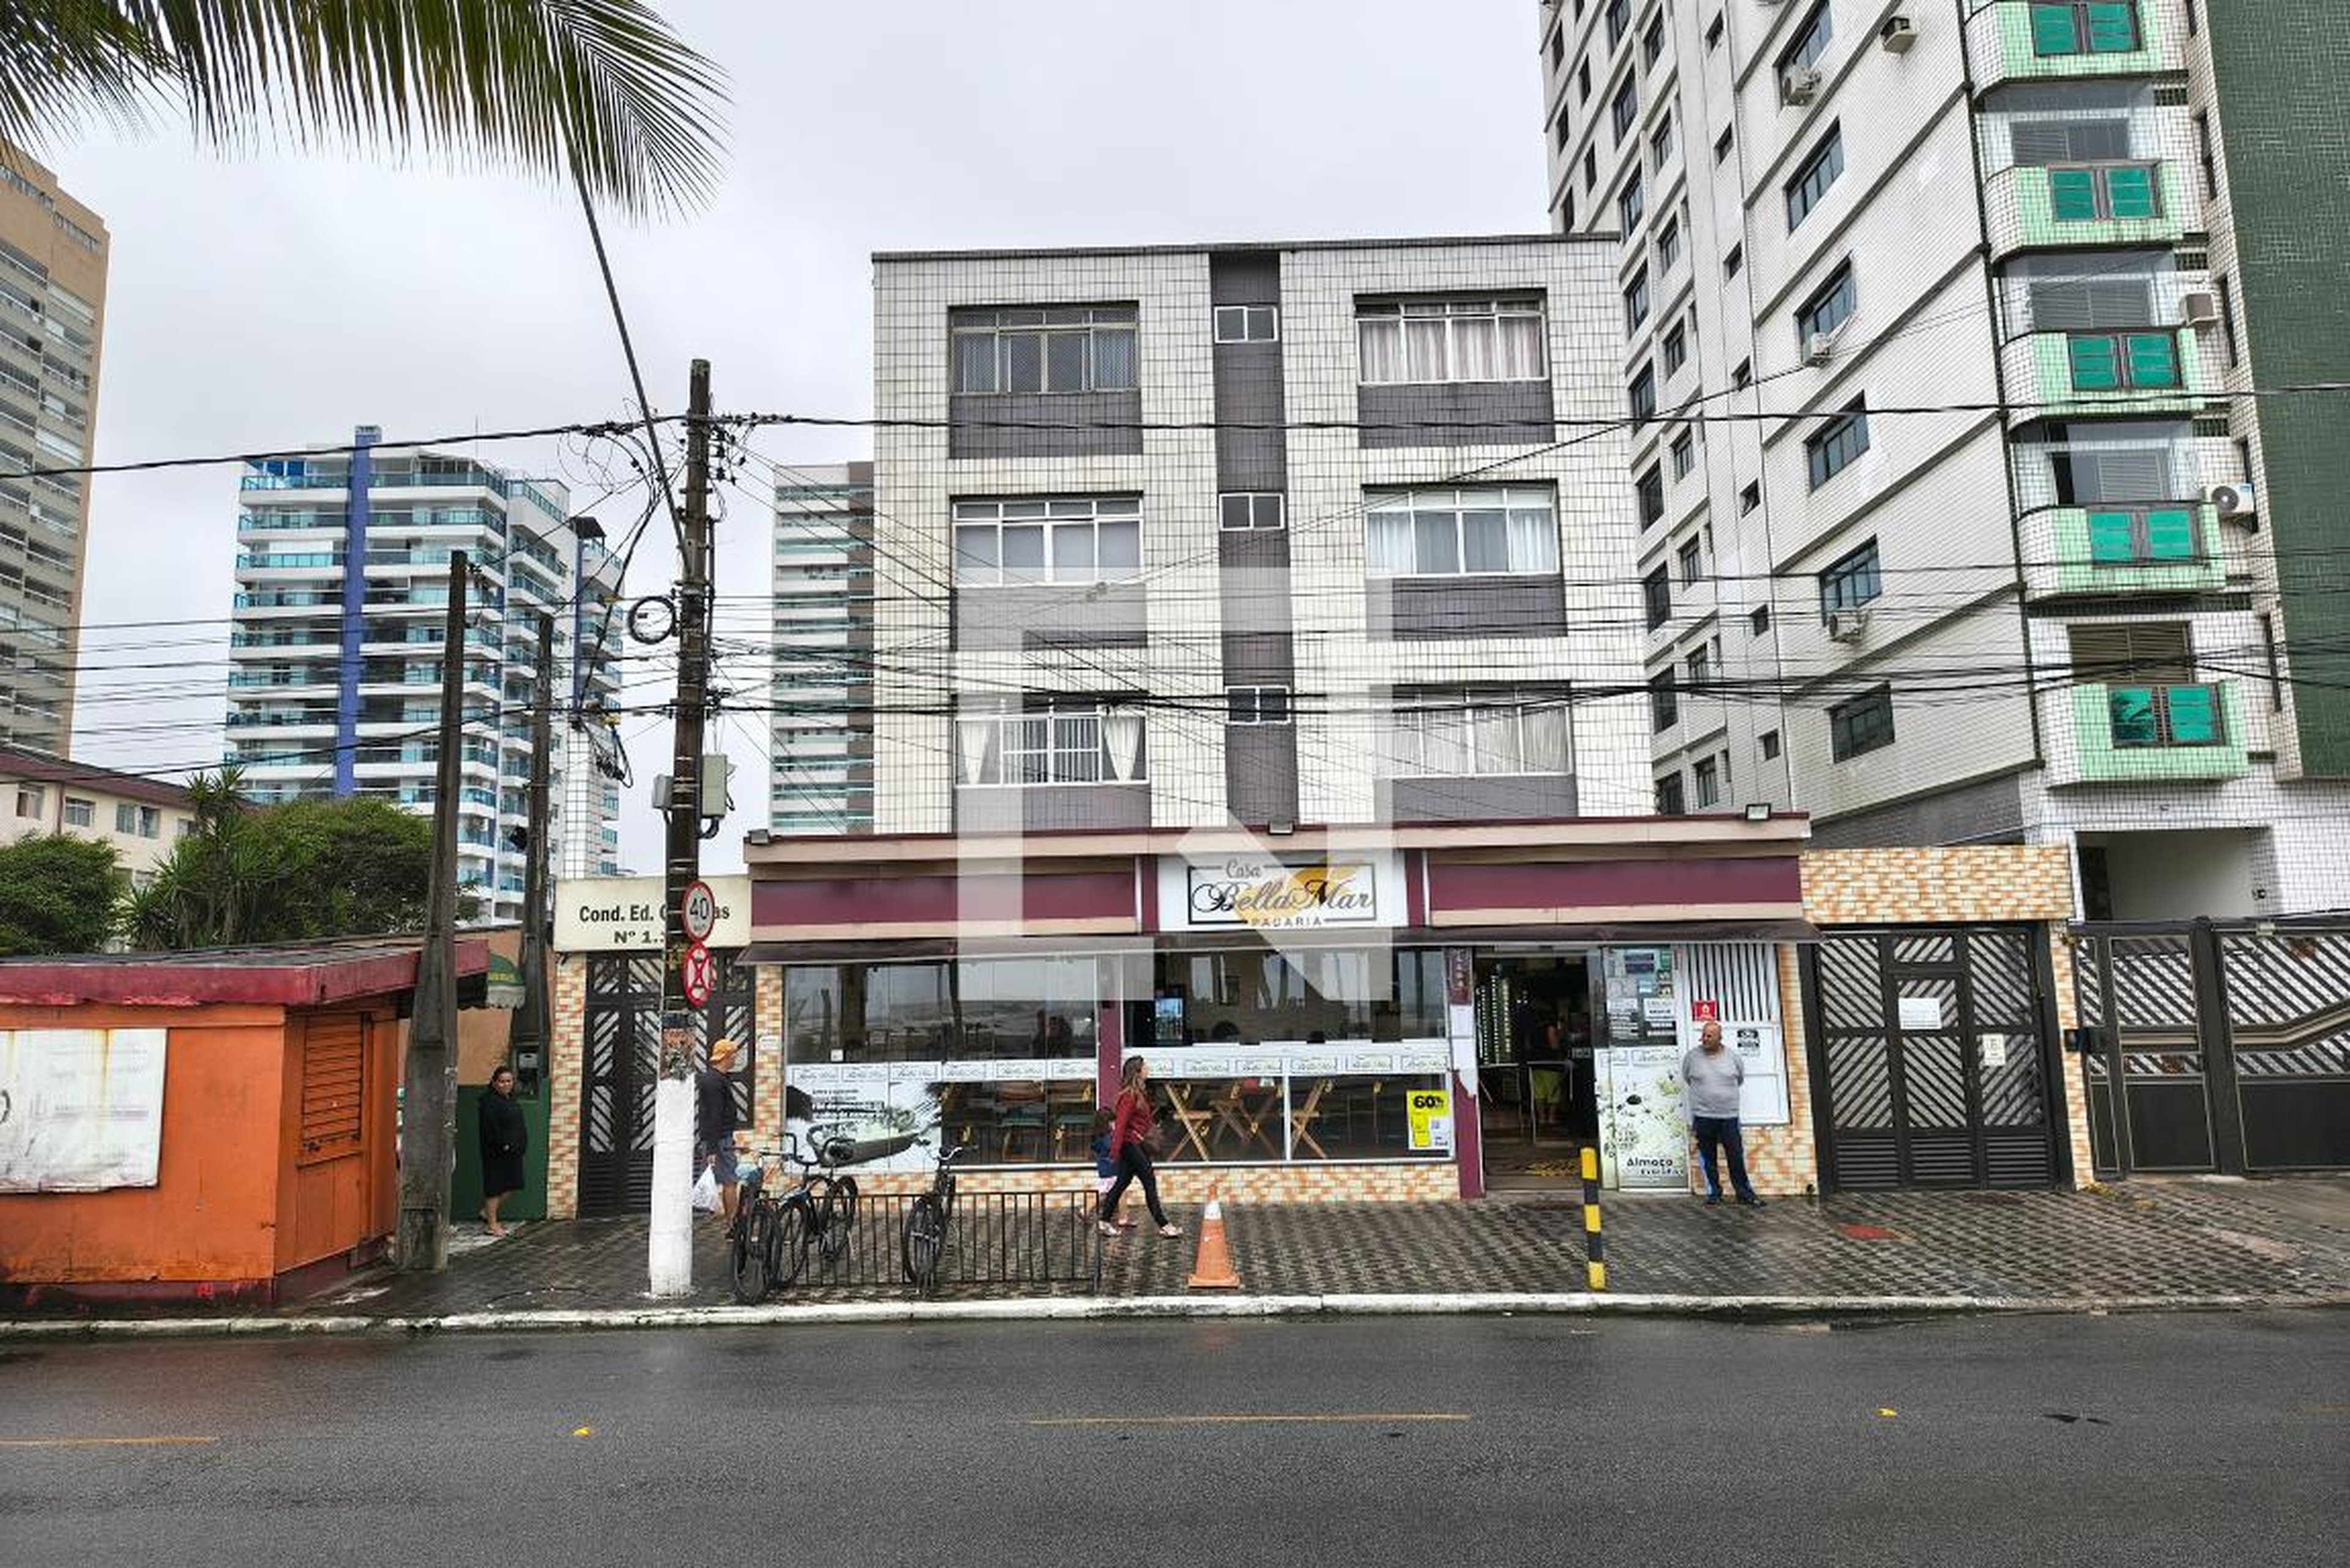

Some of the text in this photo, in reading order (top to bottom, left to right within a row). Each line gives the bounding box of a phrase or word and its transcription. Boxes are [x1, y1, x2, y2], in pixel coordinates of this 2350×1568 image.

[1226, 858, 1261, 878] Casa
[579, 906, 625, 922] Cond.
[630, 905, 654, 921] Ed.
[689, 897, 709, 920] 40
